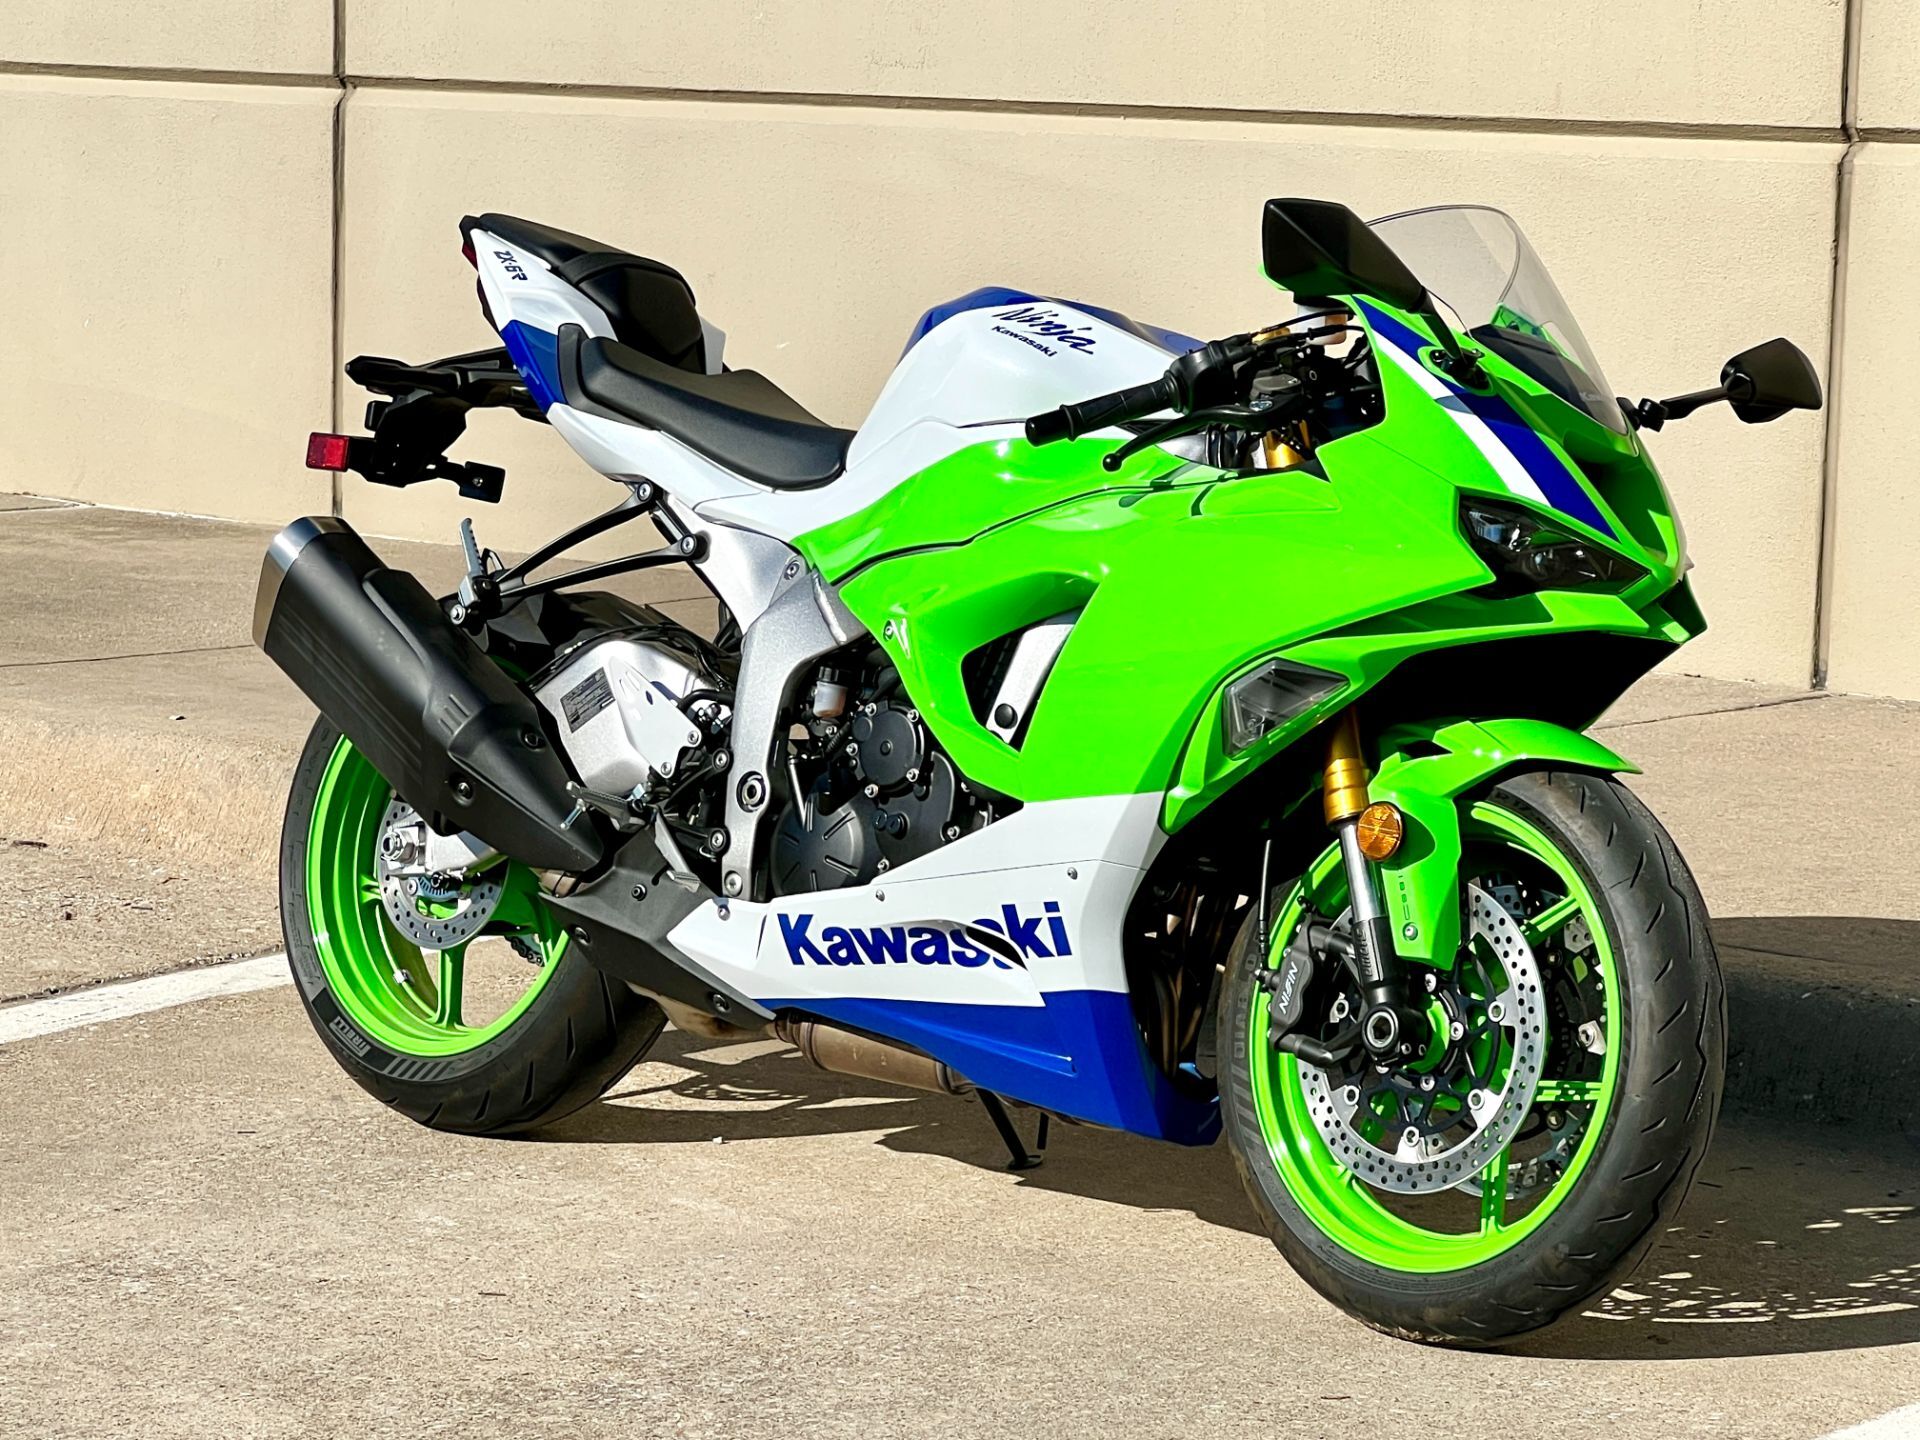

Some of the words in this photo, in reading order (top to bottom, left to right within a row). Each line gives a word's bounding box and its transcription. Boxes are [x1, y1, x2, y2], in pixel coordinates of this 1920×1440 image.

[991, 306, 1096, 355] Ninja
[991, 325, 1057, 357] Kawasaki
[776, 901, 1073, 970] Kawaski
[329, 1015, 371, 1058] PIRELLI
